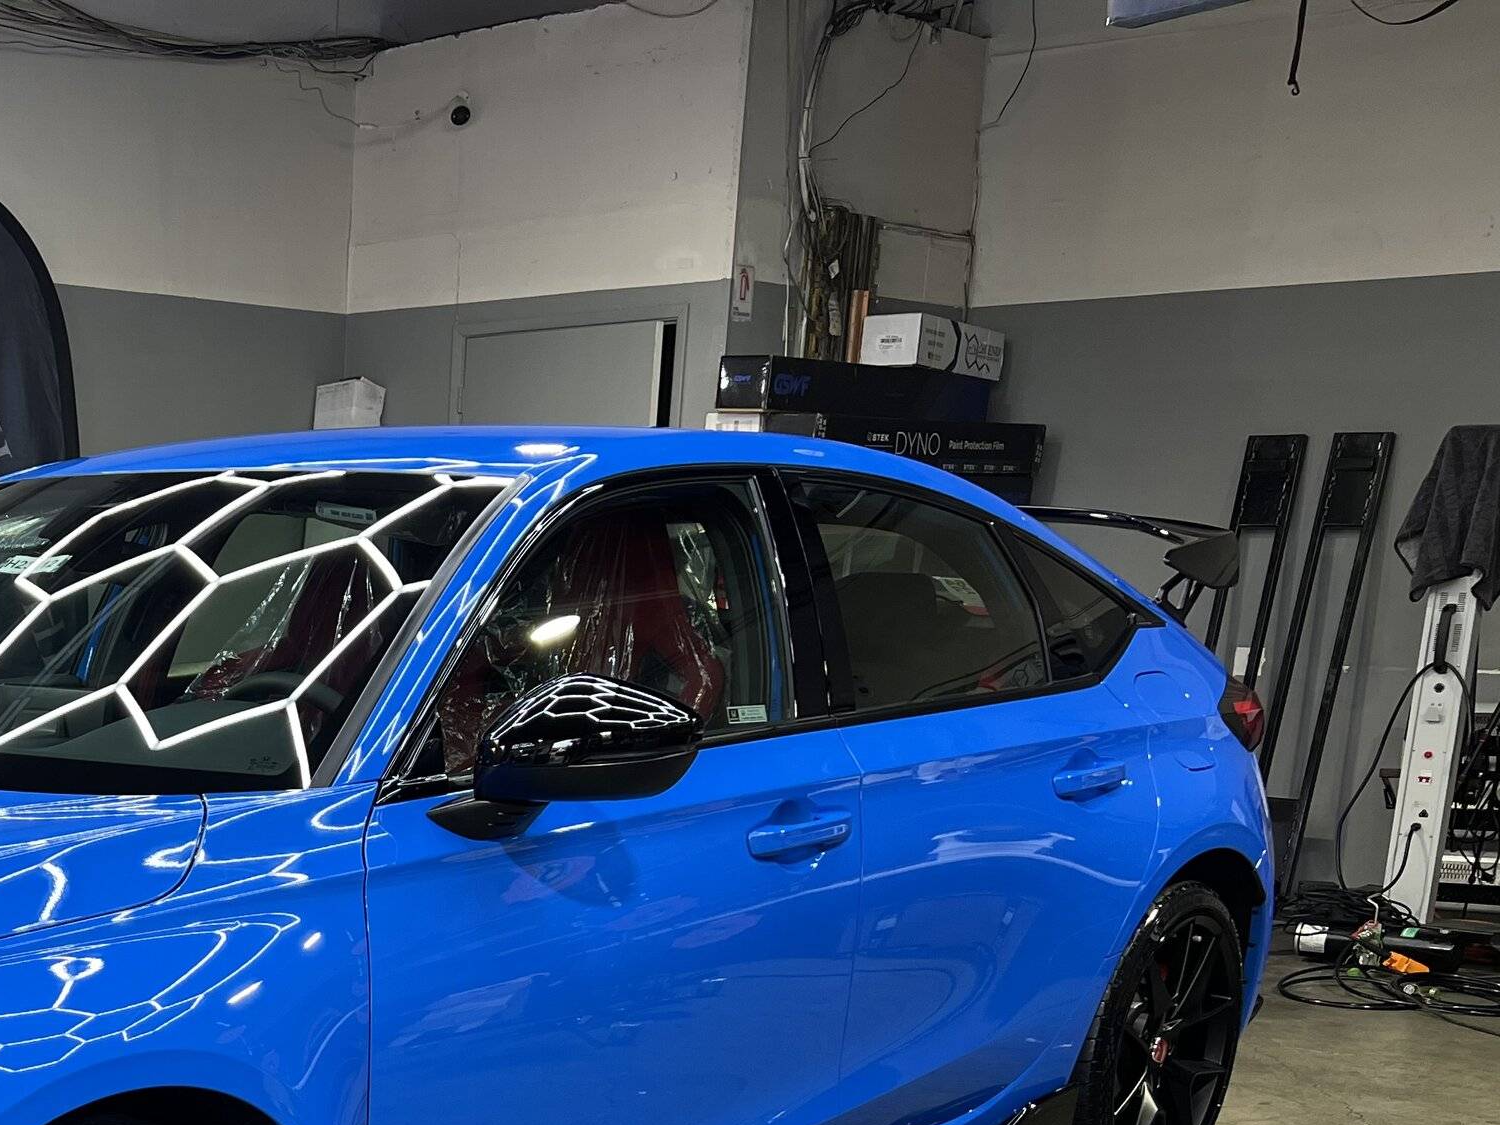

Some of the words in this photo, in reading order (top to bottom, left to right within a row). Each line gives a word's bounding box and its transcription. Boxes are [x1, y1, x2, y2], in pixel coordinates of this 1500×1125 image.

[895, 431, 941, 456] DYNO
[948, 440, 963, 450] Paint
[963, 440, 992, 450] Protection
[993, 441, 1005, 450] Film
